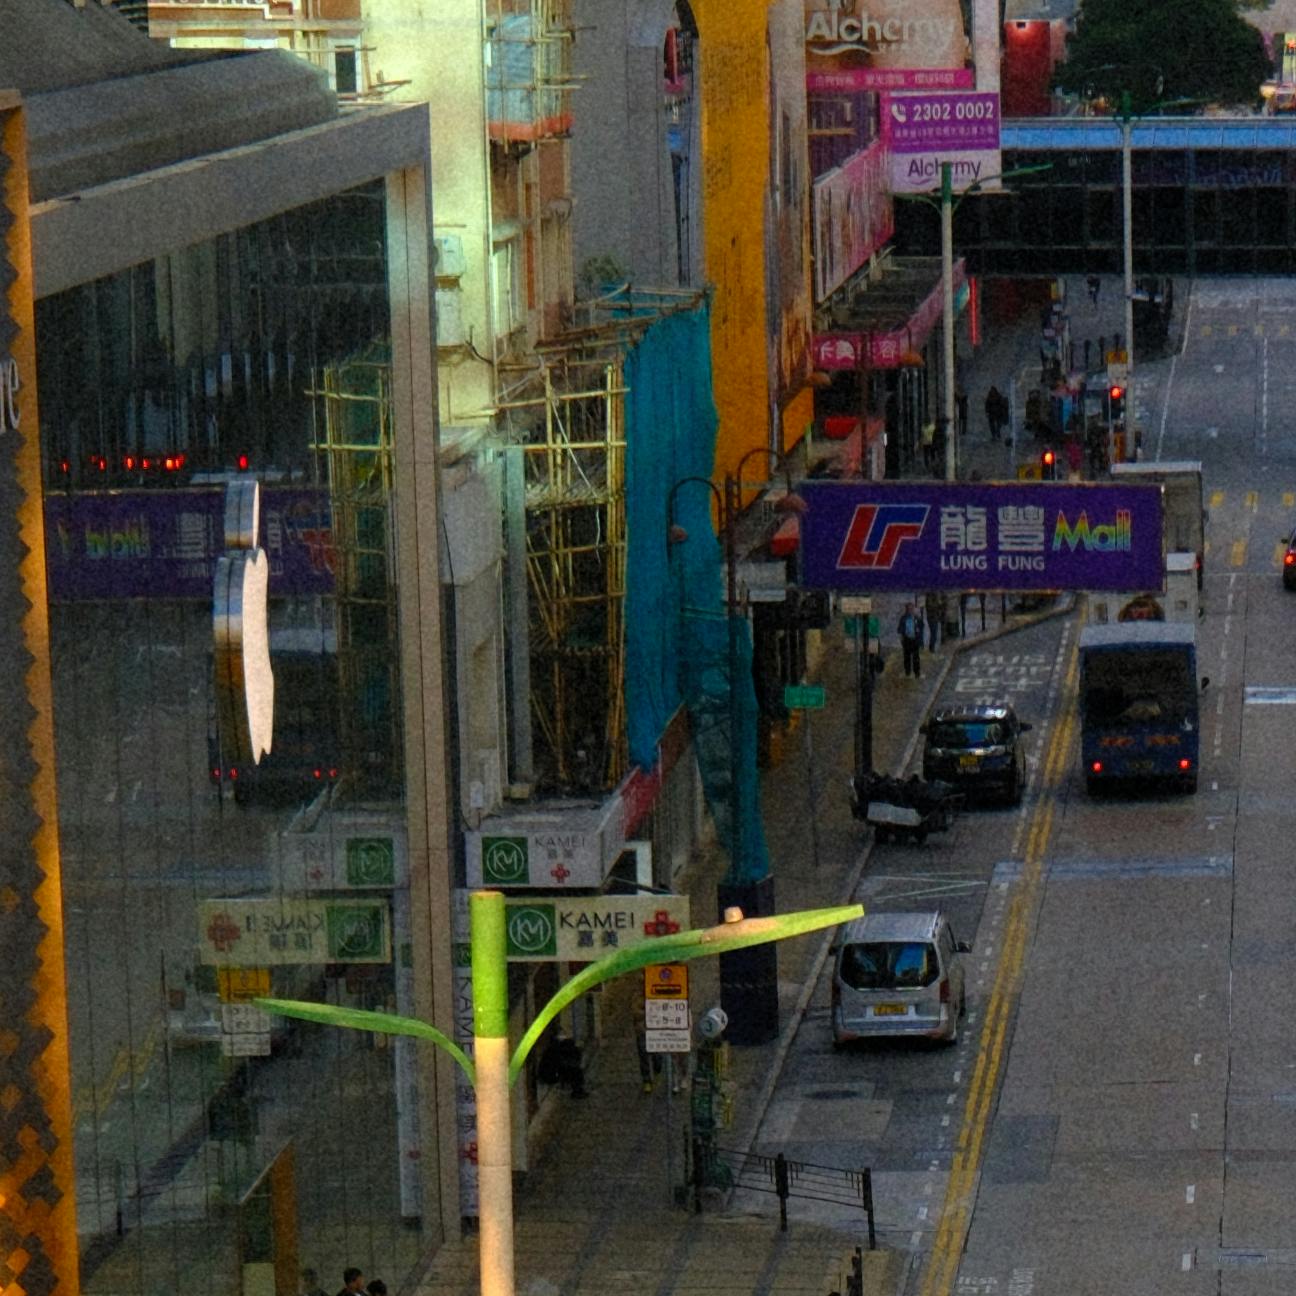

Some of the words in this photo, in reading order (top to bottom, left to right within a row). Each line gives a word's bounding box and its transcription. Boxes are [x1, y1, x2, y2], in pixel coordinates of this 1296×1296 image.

[913, 103, 950, 121] 2302
[955, 101, 994, 119] 0002
[908, 158, 981, 178] Alchmy
[940, 505, 1045, 551] 龍豐
[1052, 509, 1132, 552] Mall
[940, 555, 988, 570] LUNG
[998, 555, 1045, 570] FUNG
[560, 911, 635, 929] KAMEI
